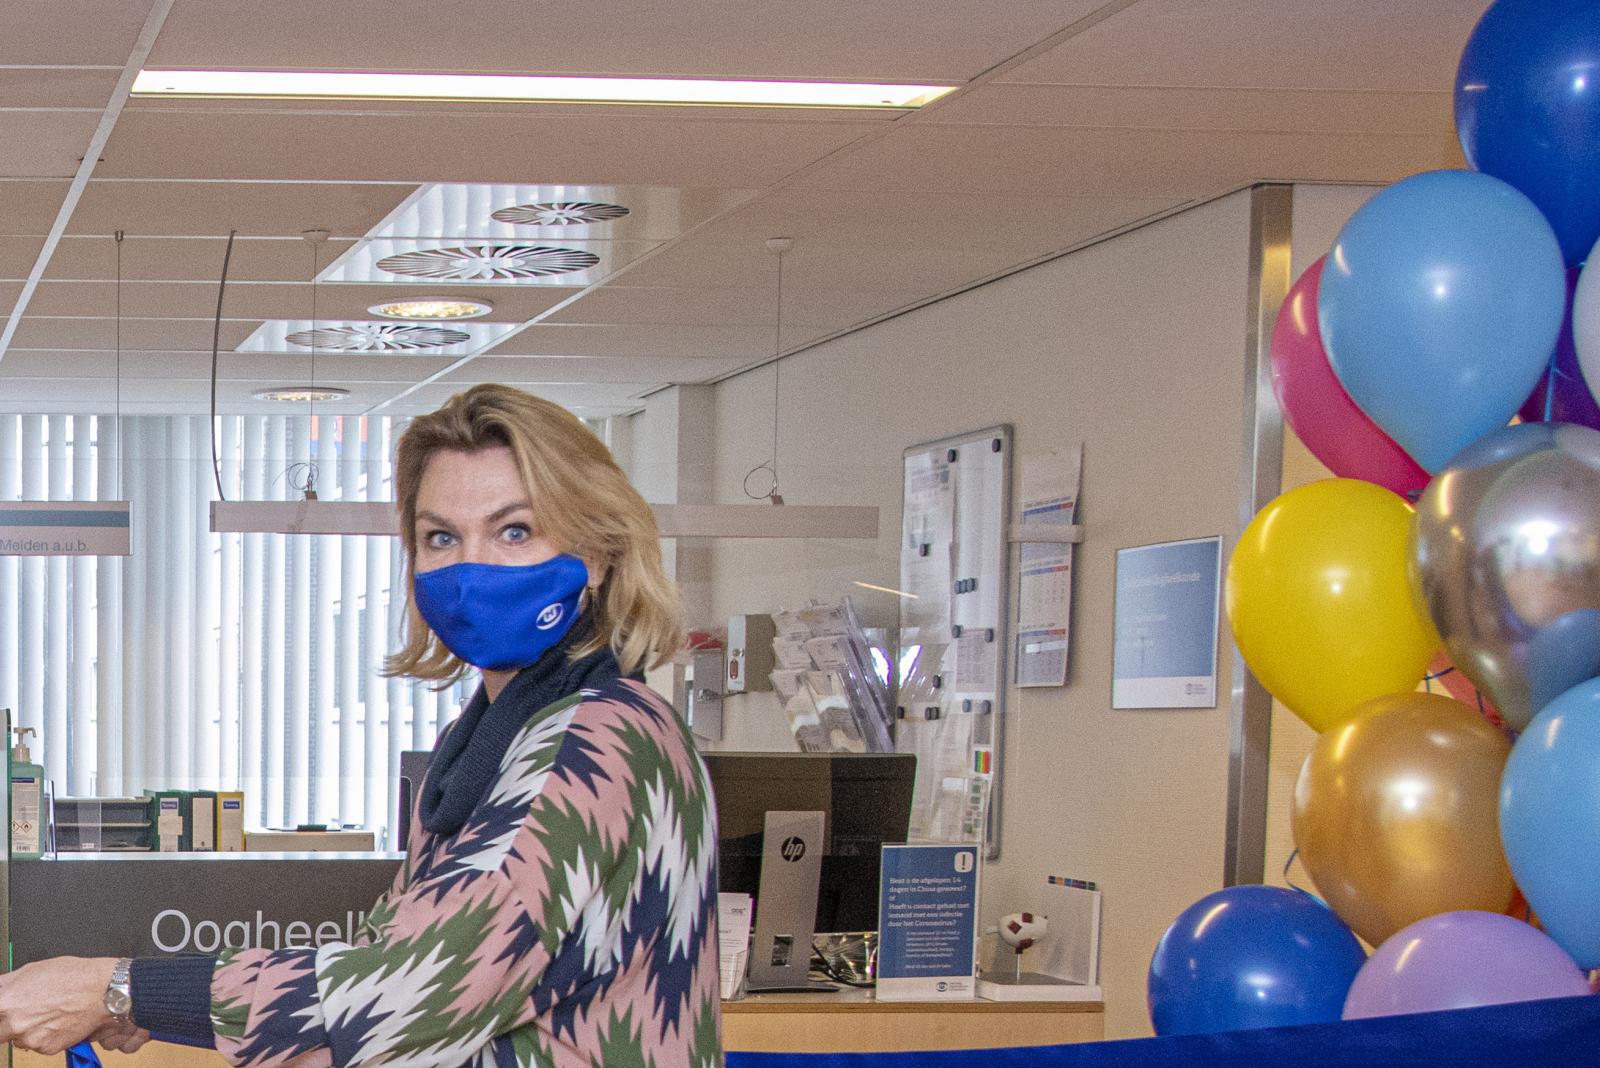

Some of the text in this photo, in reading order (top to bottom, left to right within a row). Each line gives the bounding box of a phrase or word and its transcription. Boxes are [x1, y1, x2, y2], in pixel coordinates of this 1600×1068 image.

[0, 539, 48, 551] Melden
[53, 539, 90, 551] a.u.b.
[782, 836, 804, 862] hp
